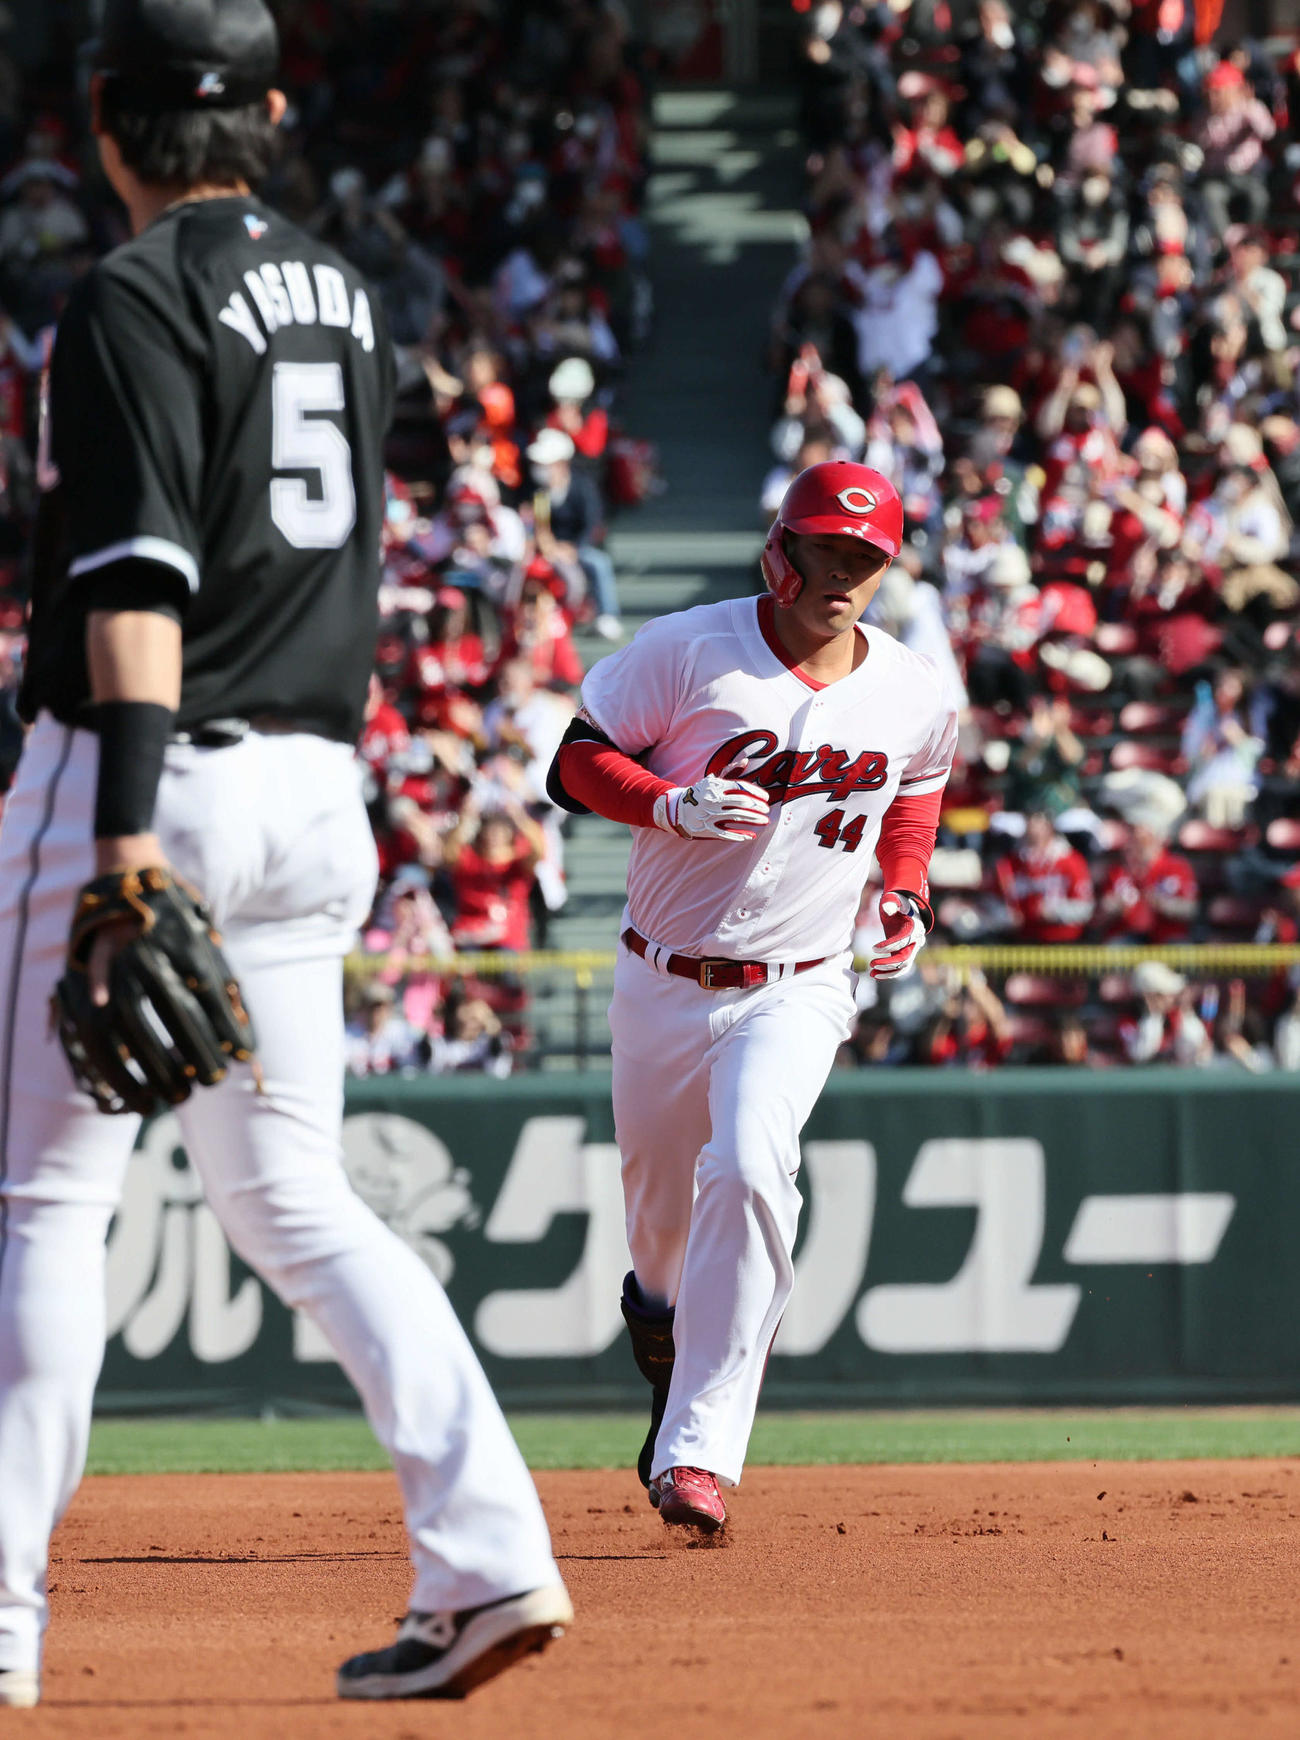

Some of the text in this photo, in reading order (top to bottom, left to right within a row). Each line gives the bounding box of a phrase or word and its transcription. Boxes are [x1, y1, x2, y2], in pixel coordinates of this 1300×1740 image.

[269, 361, 357, 550] 5
[704, 729, 889, 807] Carp
[813, 808, 868, 853] 44
